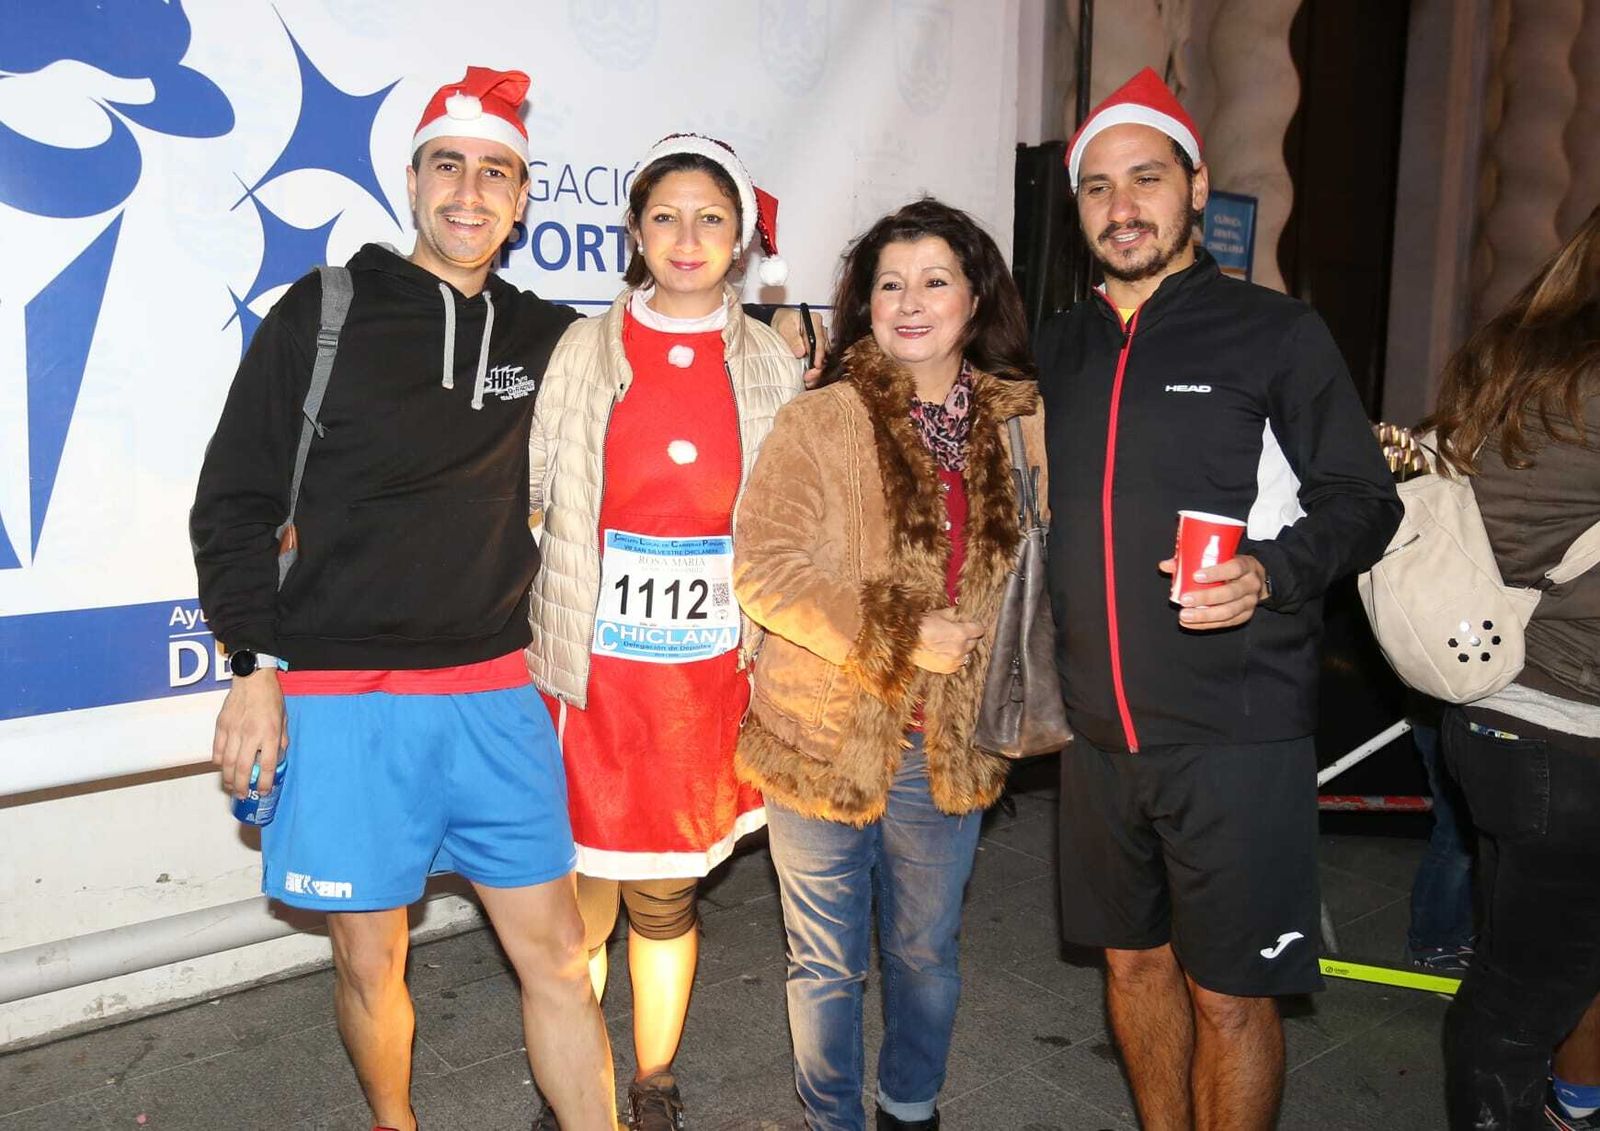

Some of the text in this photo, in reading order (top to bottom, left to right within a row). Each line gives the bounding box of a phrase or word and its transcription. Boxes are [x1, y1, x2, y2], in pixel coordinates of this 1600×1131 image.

[1165, 384, 1212, 393] HEAD
[638, 555, 668, 566] ROSA
[615, 574, 709, 620] 1112
[599, 622, 733, 654] CHICLANA
